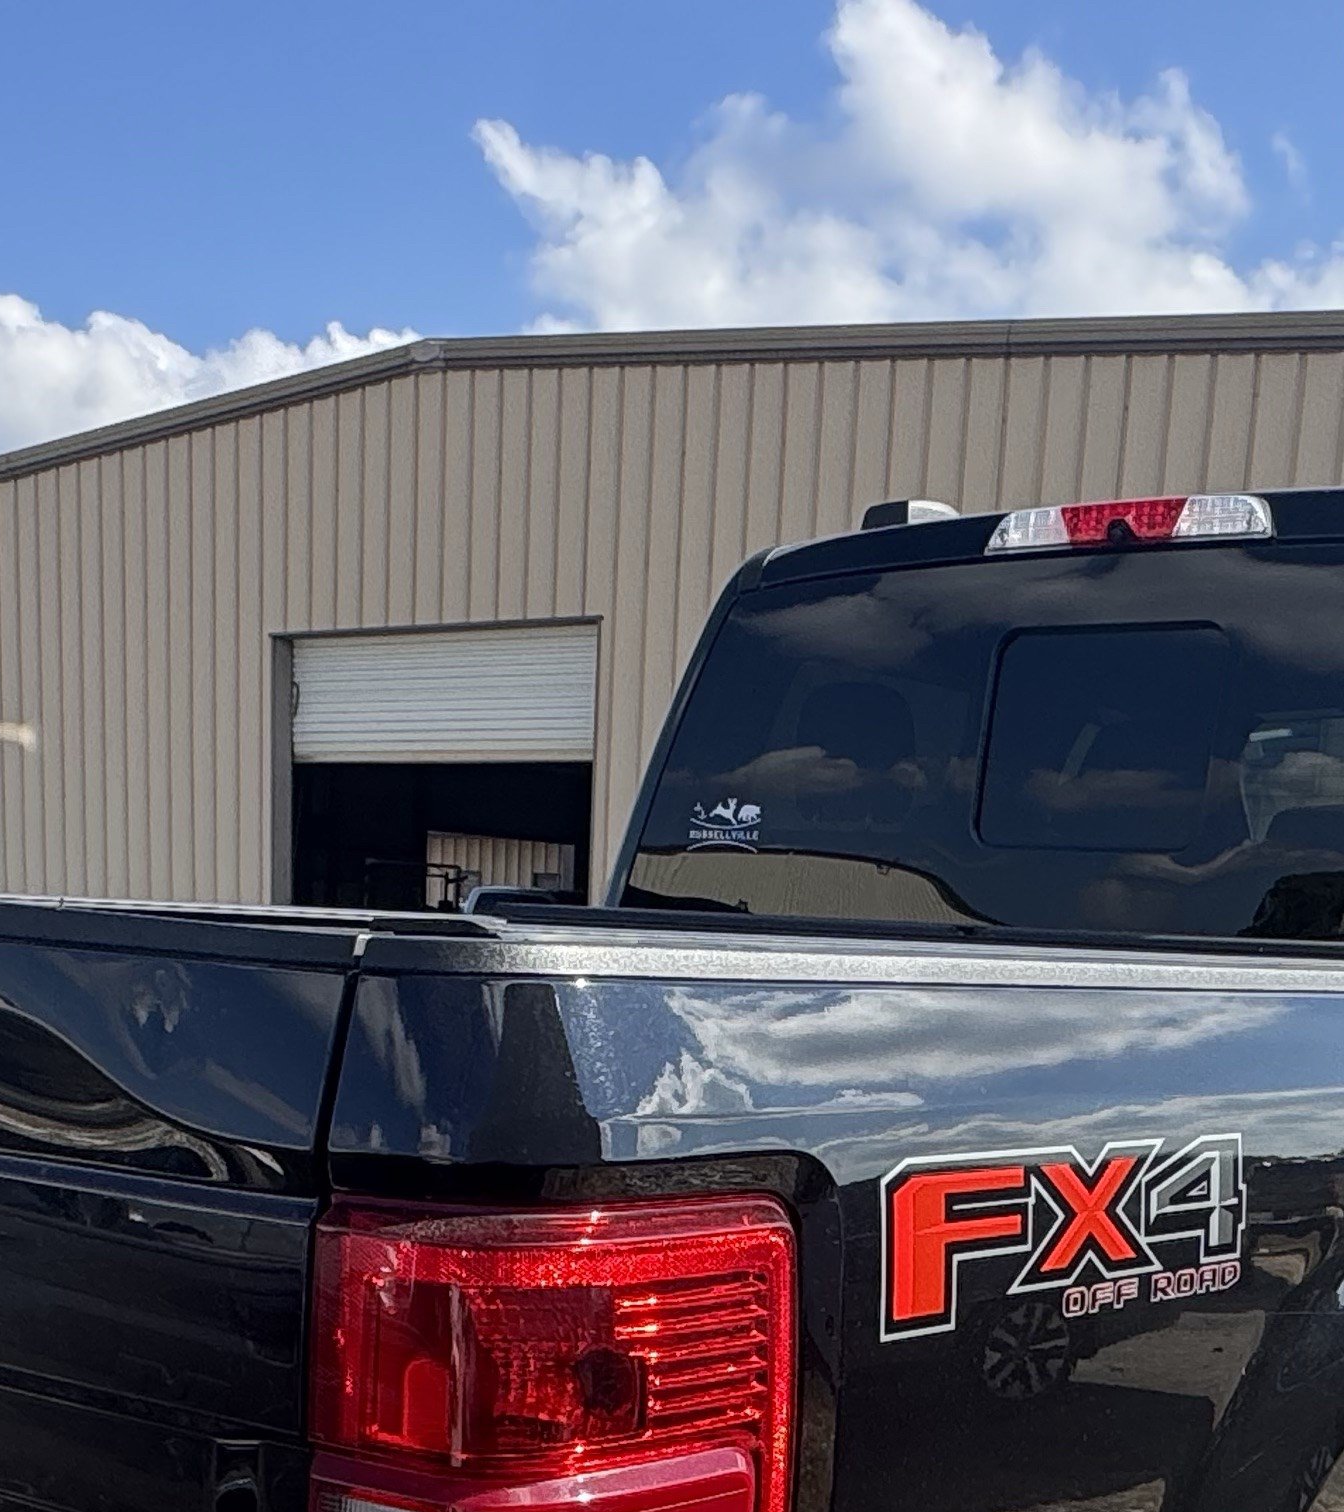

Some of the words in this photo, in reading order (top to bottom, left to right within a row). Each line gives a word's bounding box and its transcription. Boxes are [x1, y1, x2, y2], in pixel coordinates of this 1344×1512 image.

[880, 1132, 1247, 1343] FX4
[1061, 1277, 1139, 1319] OFF
[1150, 1260, 1242, 1303] ROAD
